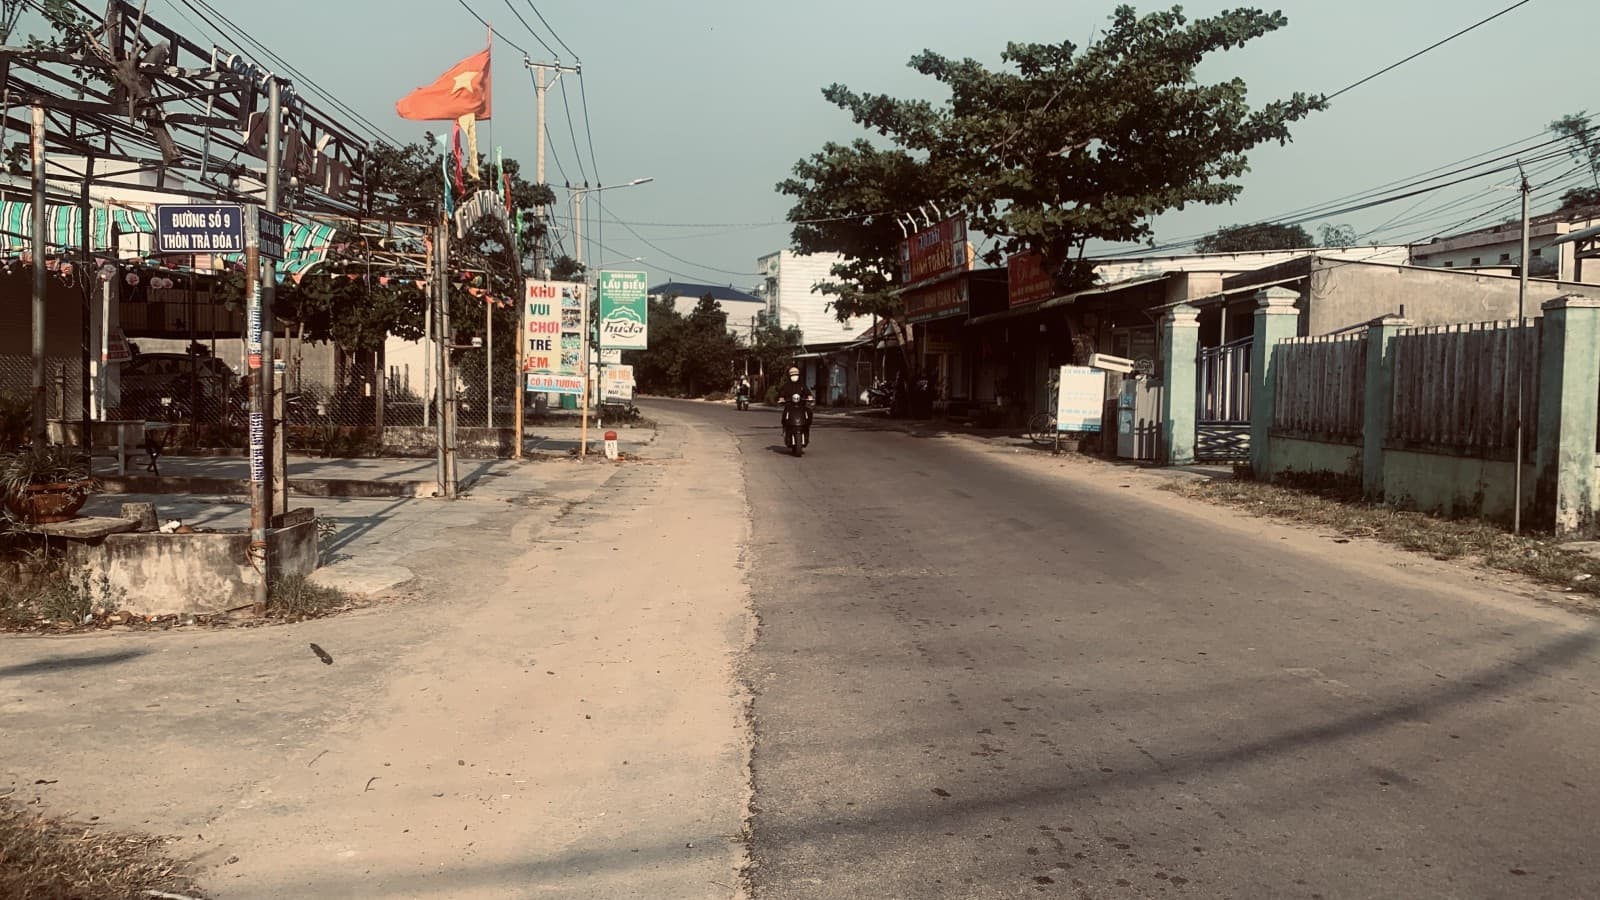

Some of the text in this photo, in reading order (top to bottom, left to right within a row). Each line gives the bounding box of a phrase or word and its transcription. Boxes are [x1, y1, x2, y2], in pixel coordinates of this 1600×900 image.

[172, 208, 231, 228] ĐƯỜNG SỐ 9
[163, 232, 189, 249] THÔN
[192, 232, 210, 249] TRÀ
[212, 232, 232, 249] ĐÓA
[235, 234, 240, 249] 1
[530, 285, 556, 298] KHU
[530, 303, 550, 316] VUI
[529, 321, 559, 333] CHƠI
[529, 336, 552, 351] TRẺ
[529, 356, 549, 369] EM
